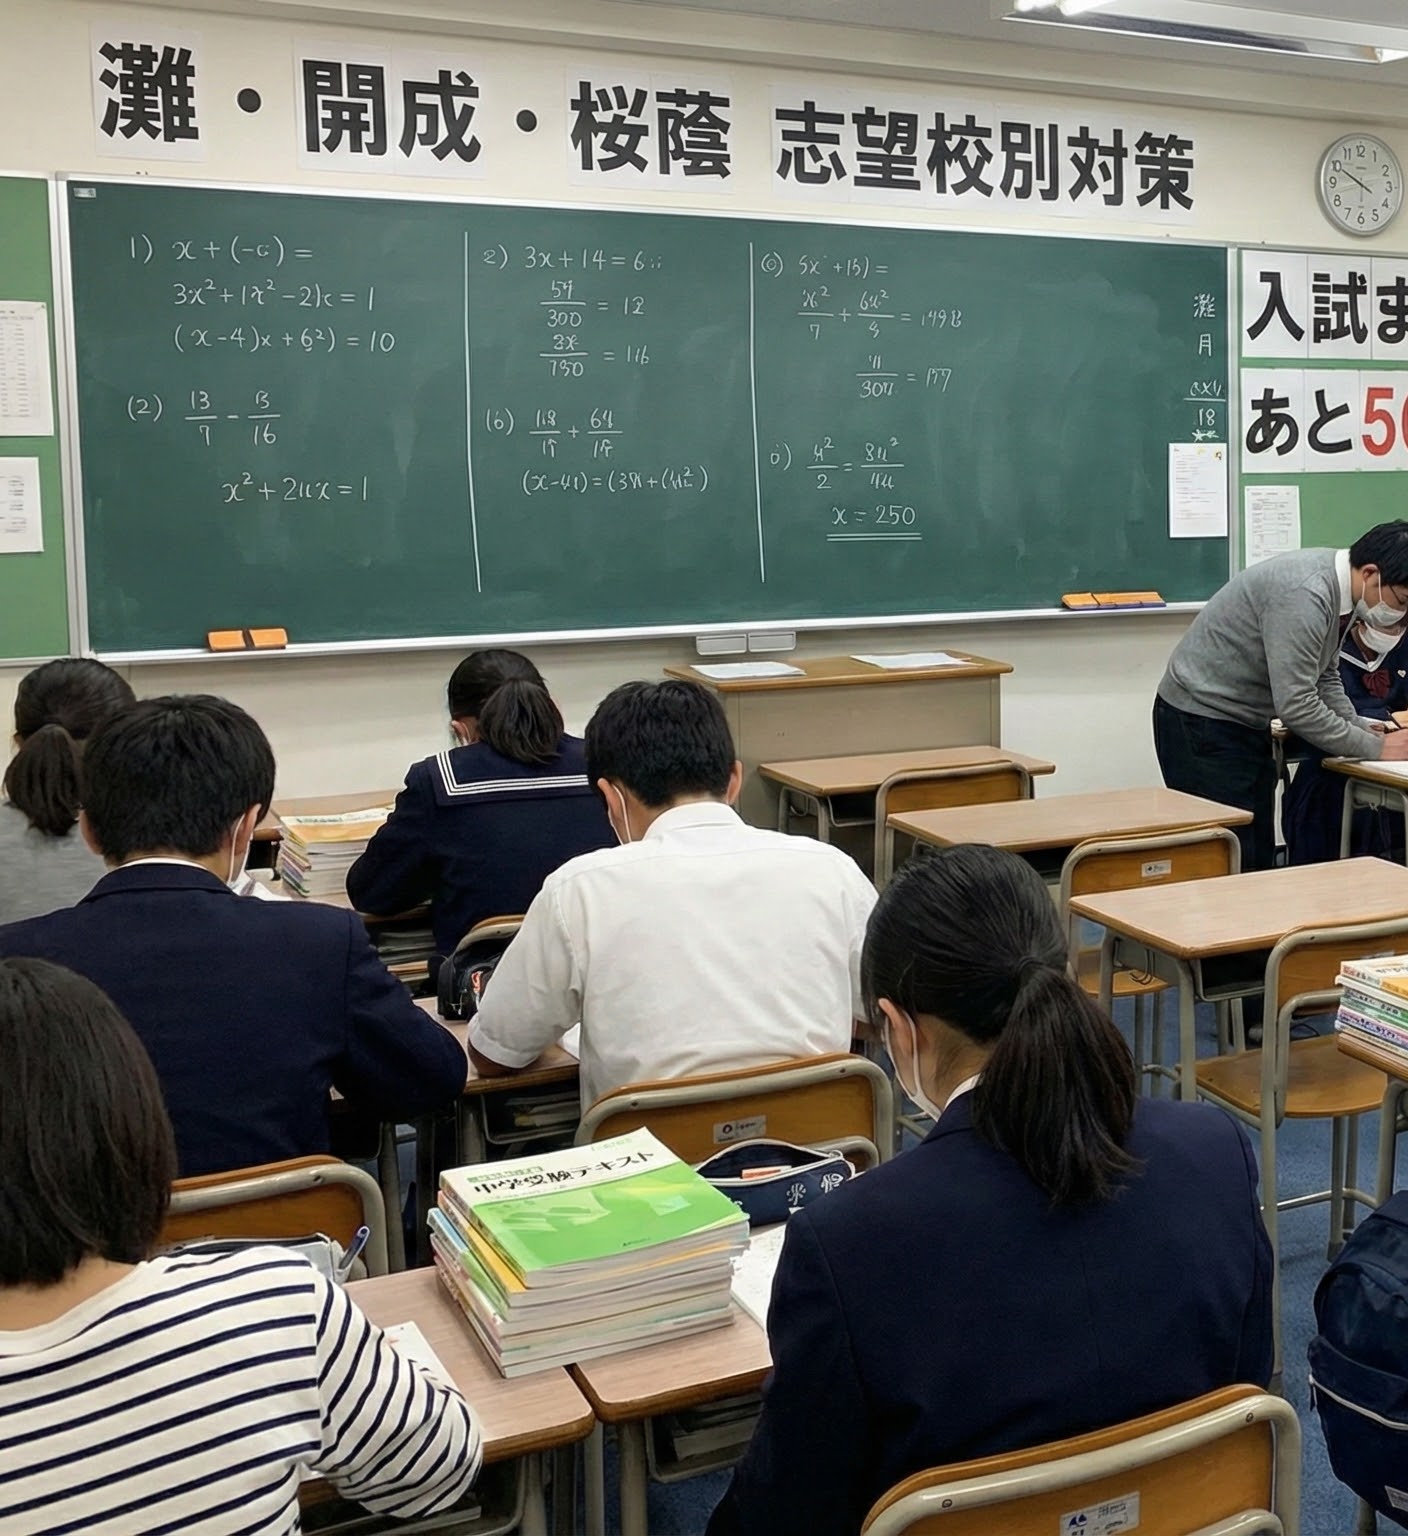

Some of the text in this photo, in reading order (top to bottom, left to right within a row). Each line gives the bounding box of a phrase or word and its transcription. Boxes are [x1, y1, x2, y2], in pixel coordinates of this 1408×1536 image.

[98, 41, 1196, 211] 灘・開成・桜蔭 志望校別対策
[1342, 146, 1351, 160] 11
[1356, 145, 1366, 158] 12
[1373, 150, 1377, 162] 1
[1331, 160, 1342, 173] 10
[1382, 164, 1390, 177] 2
[1329, 176, 1337, 189] 9
[1385, 181, 1393, 193] 3
[1333, 194, 1342, 207] 8
[1382, 197, 1389, 208] 4
[1344, 207, 1352, 221] 7
[1357, 211, 1365, 225] 6
[1371, 208, 1379, 222] 5
[547, 309, 582, 327] 300
[1198, 333, 1212, 357] 月
[127, 394, 163, 422] (2)
[1199, 408, 1216, 427] 18
